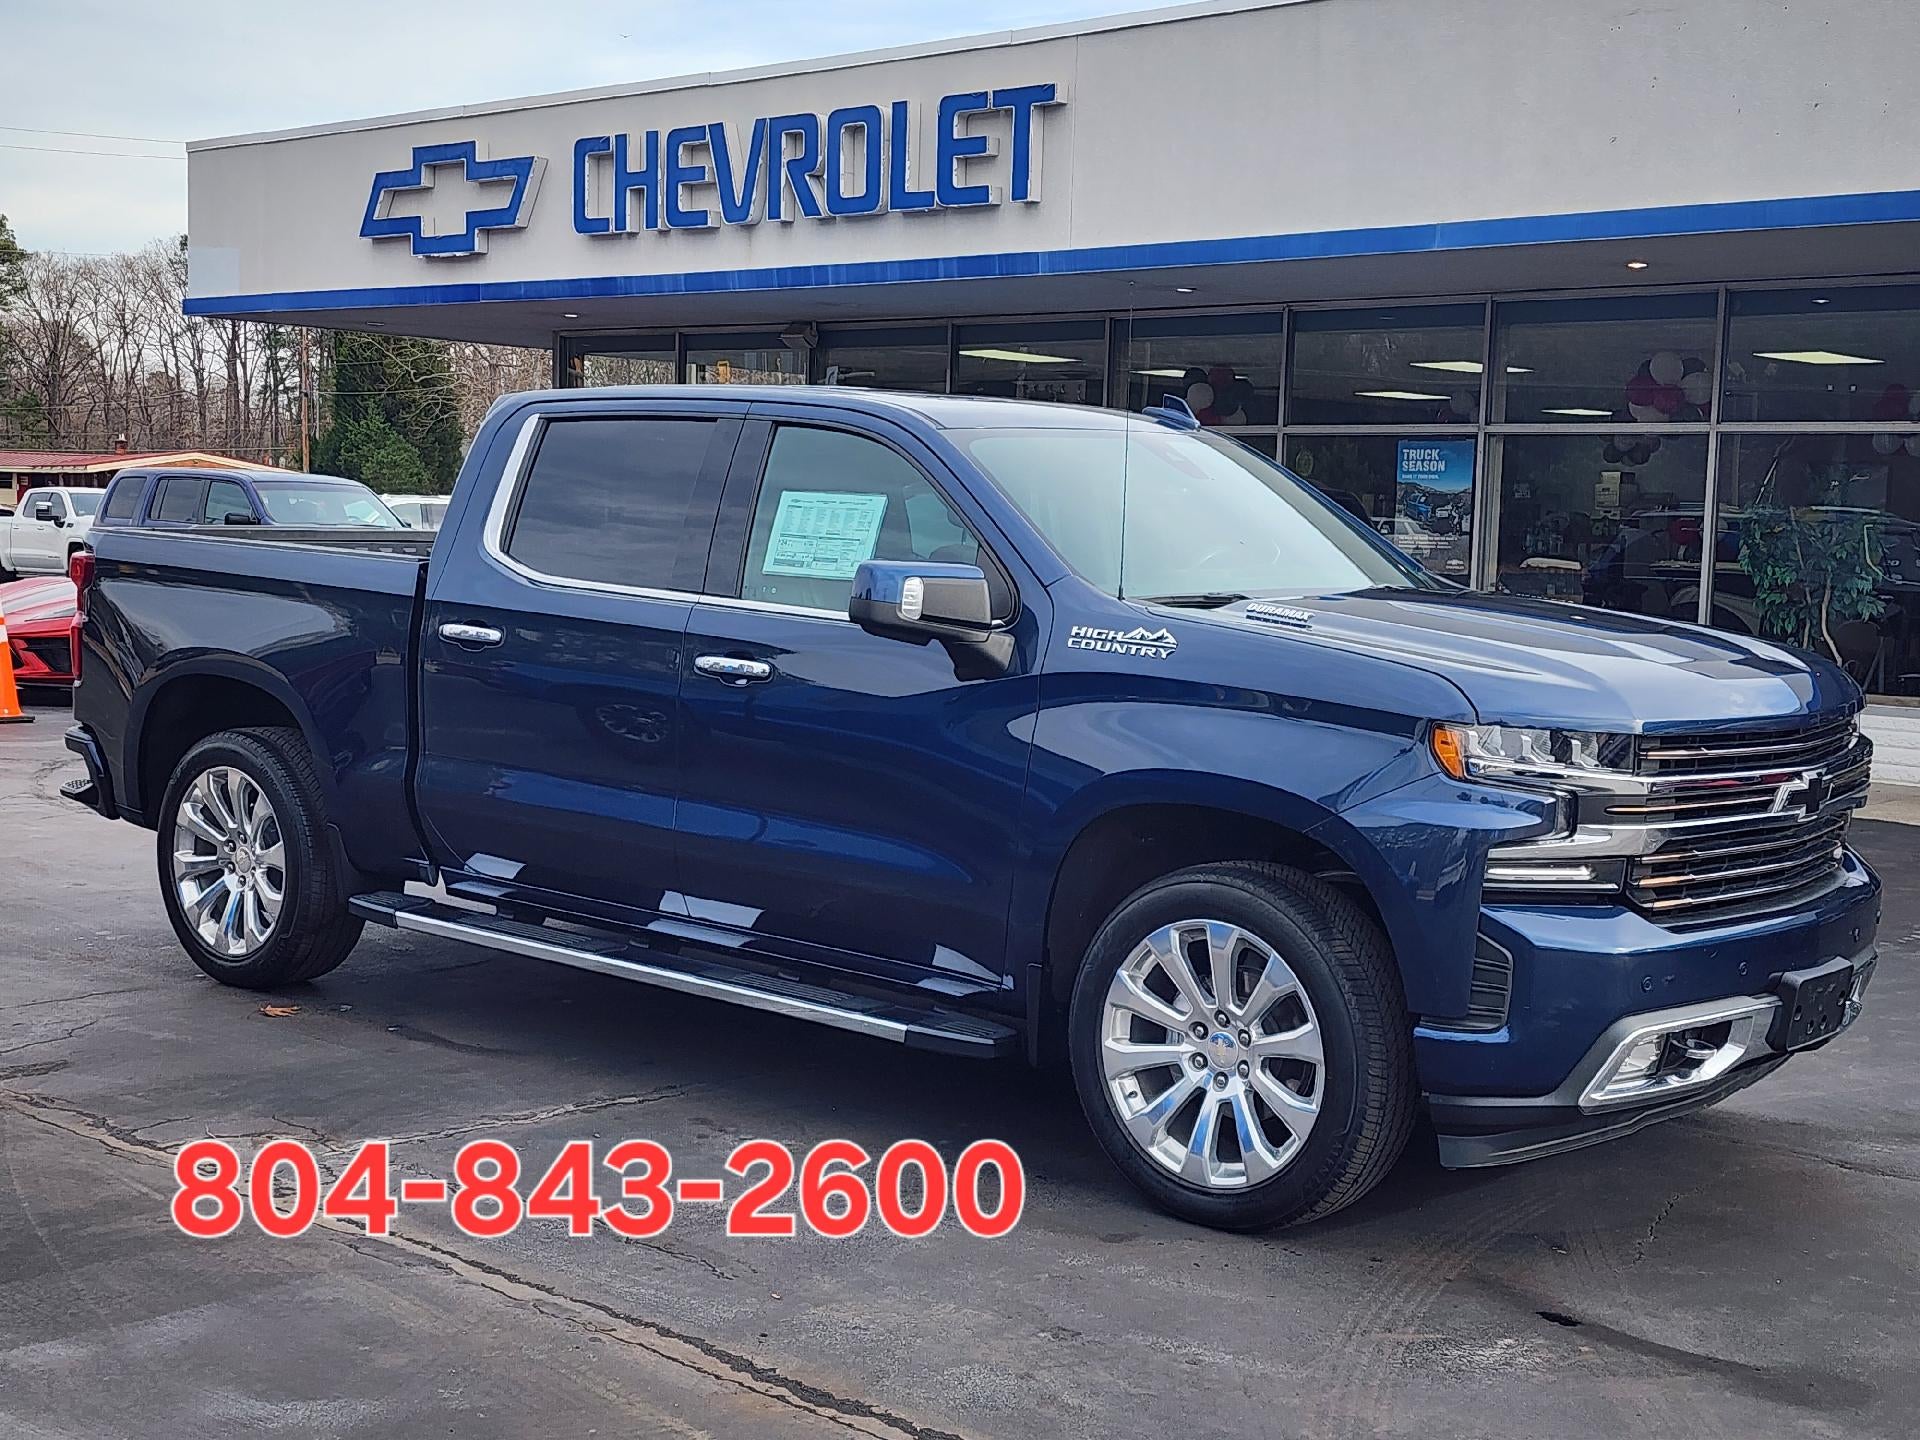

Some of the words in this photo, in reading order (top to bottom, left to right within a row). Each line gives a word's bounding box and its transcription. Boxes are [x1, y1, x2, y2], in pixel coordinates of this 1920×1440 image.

[573, 83, 1062, 236] CHEVROLET
[1402, 448, 1440, 461] TRUCK
[1402, 460, 1446, 472] SEASON
[1246, 602, 1316, 621] DURAMAX
[1069, 625, 1125, 641] HIGH
[1067, 637, 1176, 659] COUNTRY
